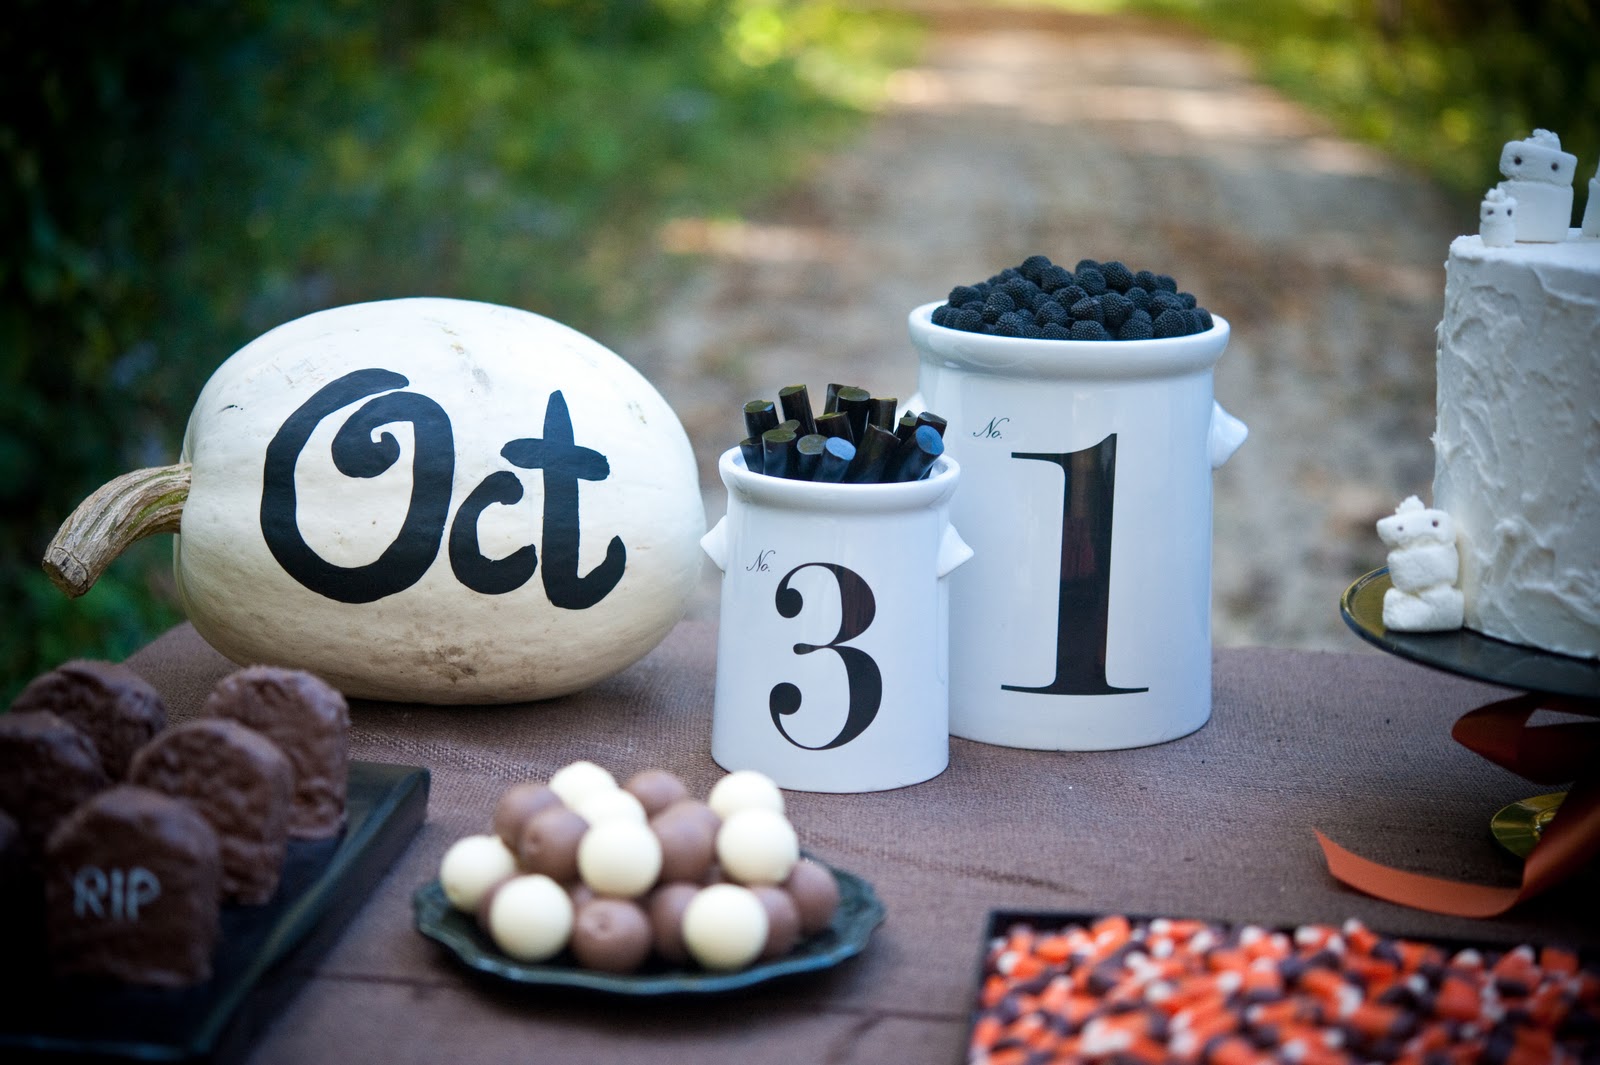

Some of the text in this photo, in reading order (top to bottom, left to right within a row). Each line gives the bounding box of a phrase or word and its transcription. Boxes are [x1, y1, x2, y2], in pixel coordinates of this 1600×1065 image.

[260, 368, 626, 610] Oct
[973, 417, 1010, 439] No.
[746, 549, 776, 572] No.
[1001, 432, 1149, 696] 1
[769, 562, 882, 751] 3
[71, 865, 162, 923] RIP
